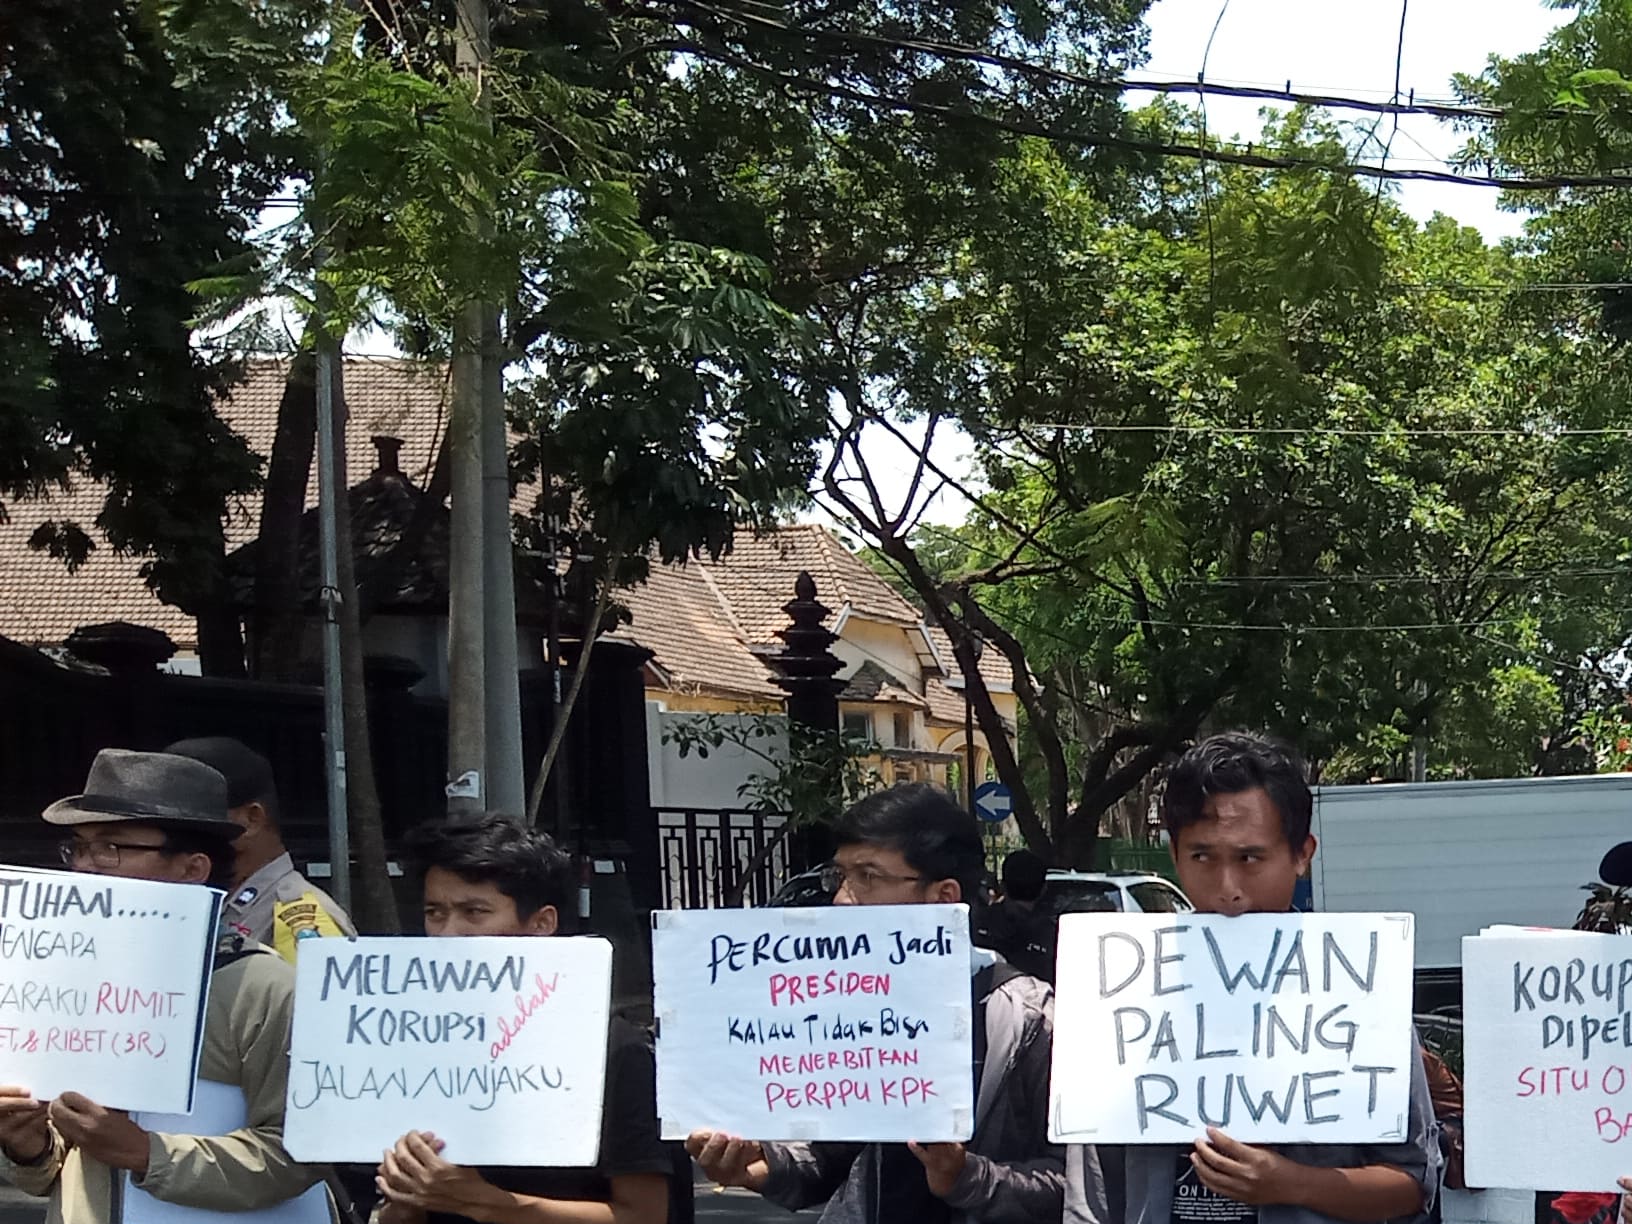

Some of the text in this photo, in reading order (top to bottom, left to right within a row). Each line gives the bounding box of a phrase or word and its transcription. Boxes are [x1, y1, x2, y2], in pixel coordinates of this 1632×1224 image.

[0, 924, 97, 960] ENGAPA
[888, 926, 952, 965] Jadi
[1098, 925, 1378, 998] DEWAN
[320, 954, 524, 1001] MELAWAN
[770, 970, 890, 1006] PRESIDEN
[0, 981, 87, 1016] ARAKU
[346, 972, 558, 1059] KORUPSI adalah
[46, 1027, 107, 1053] RIBET
[1113, 1002, 1360, 1065] PALING
[293, 1060, 407, 1110] JALAN
[765, 1076, 938, 1112] PERPPU KPK
[1135, 1064, 1397, 1134] RUWET
[1516, 1066, 1589, 1097] SITU
